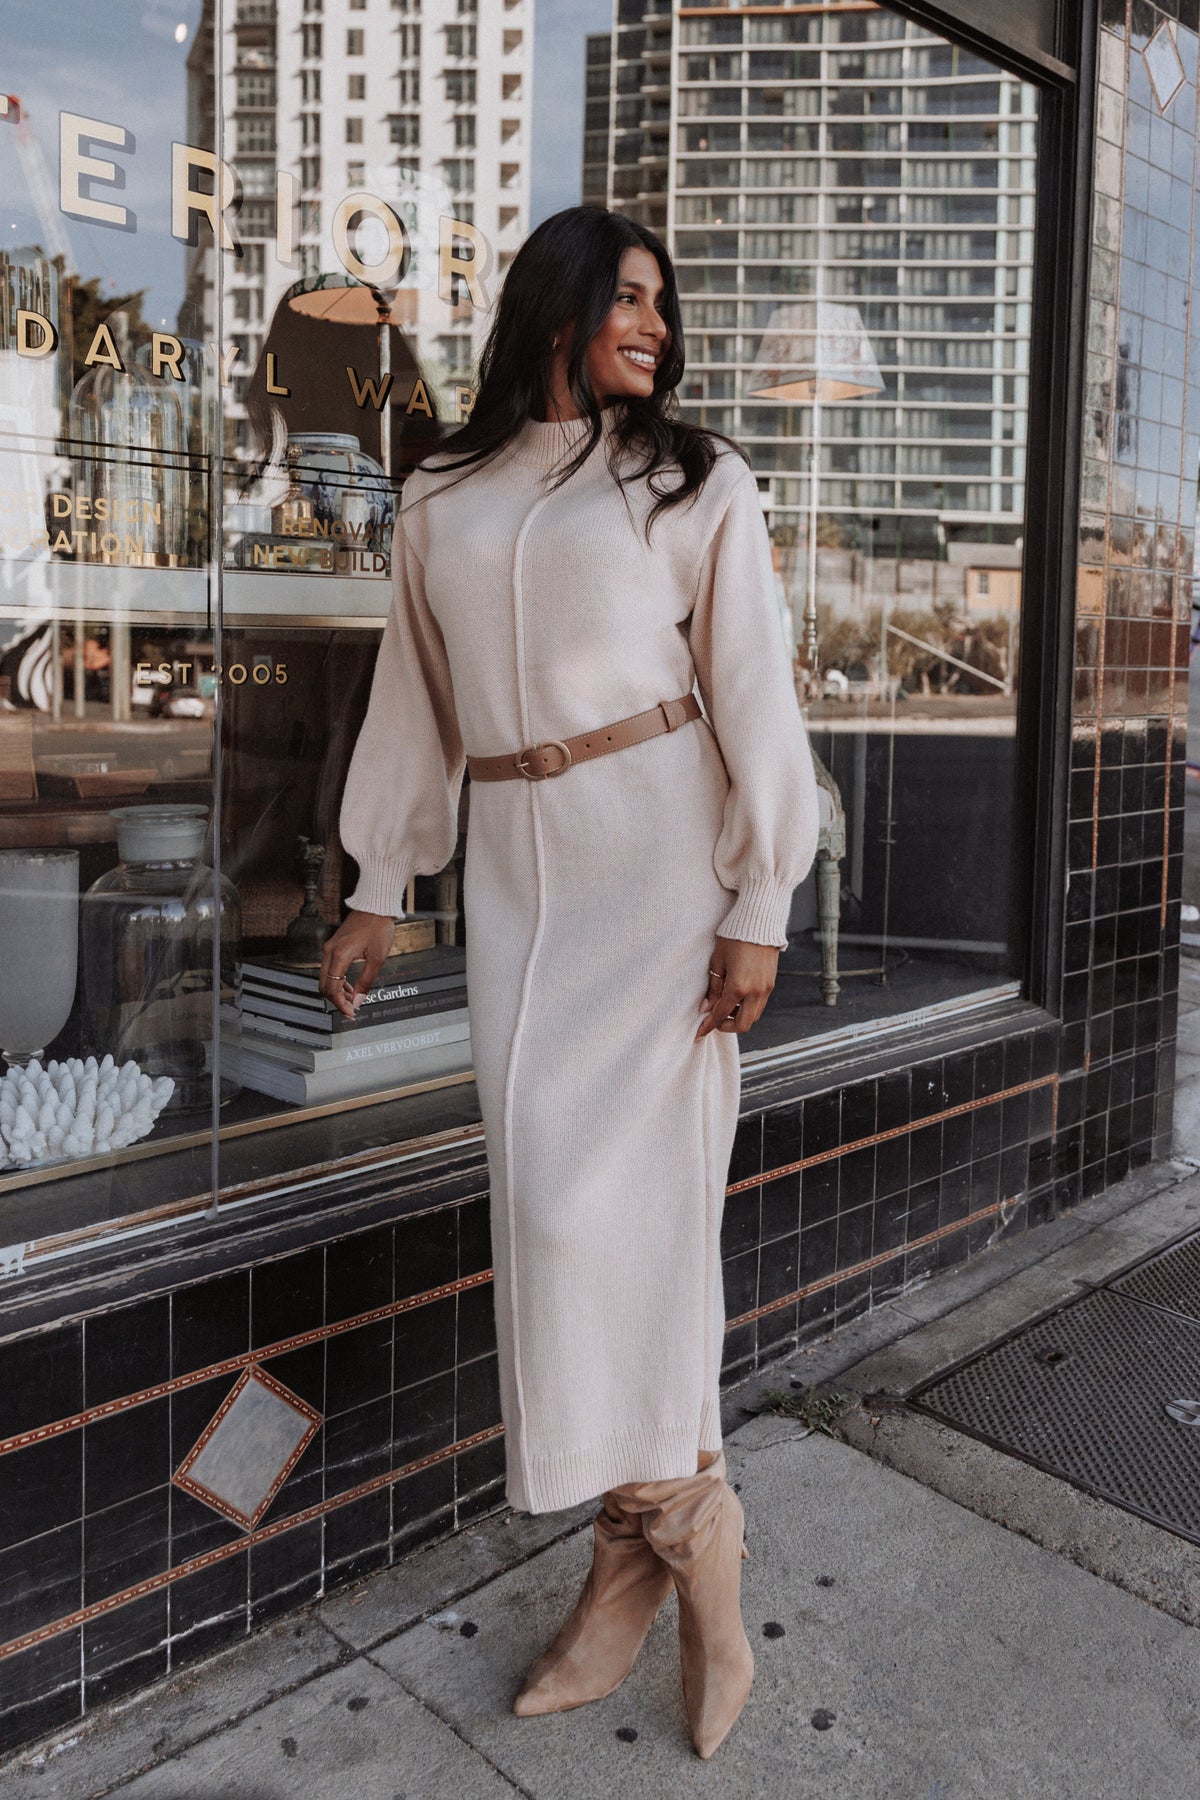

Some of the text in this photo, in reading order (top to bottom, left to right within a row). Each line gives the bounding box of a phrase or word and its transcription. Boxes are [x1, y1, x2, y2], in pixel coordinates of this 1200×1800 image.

[0, 93, 494, 312] ERIOR
[16, 309, 291, 398] DARYL
[53, 494, 162, 525] DESIGN
[253, 543, 311, 568] NEW
[136, 662, 289, 686] EST 2005
[361, 985, 419, 1005] se Gardens
[346, 1031, 441, 1061] AXEL VERVOORDT
